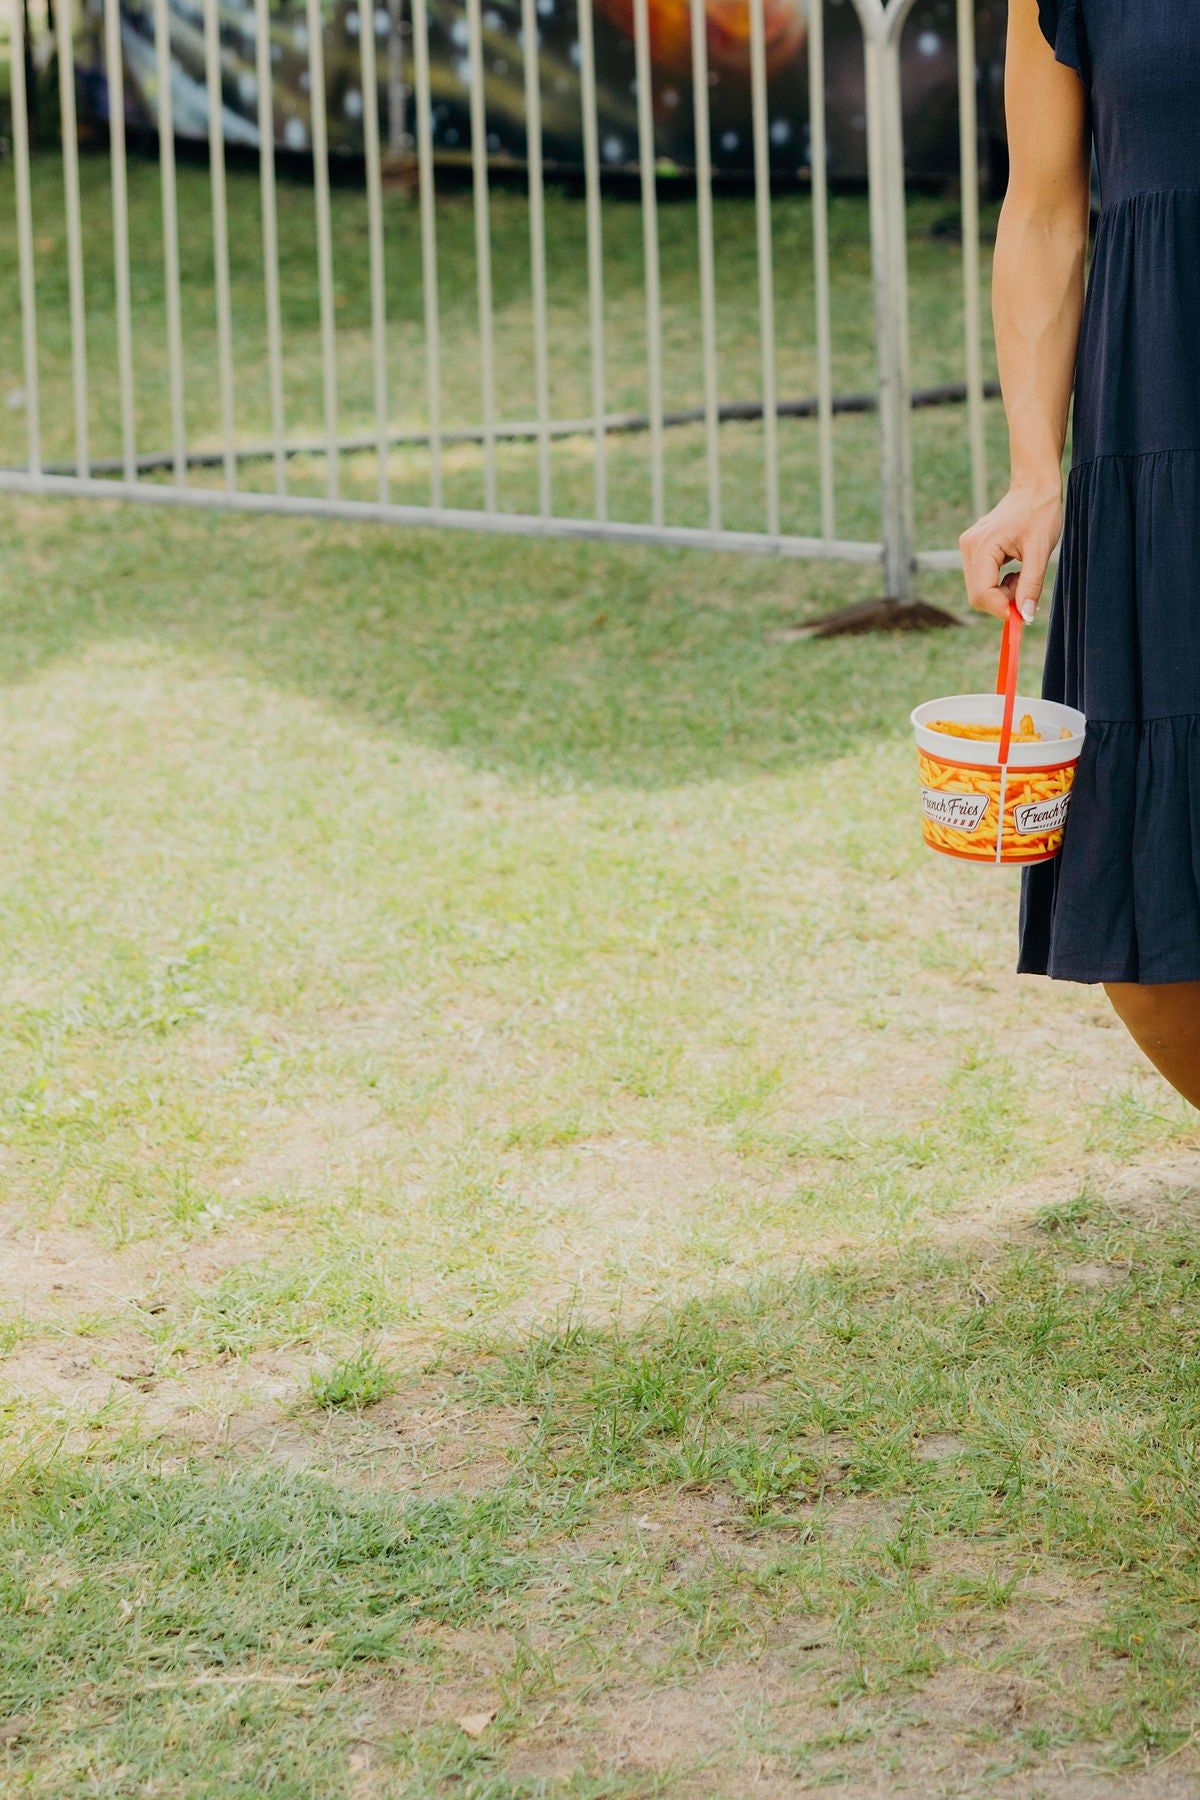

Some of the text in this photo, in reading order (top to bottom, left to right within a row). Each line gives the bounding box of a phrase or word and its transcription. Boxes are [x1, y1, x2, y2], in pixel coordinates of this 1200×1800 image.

[922, 791, 978, 816] French Fries
[1021, 803, 1060, 826] French
